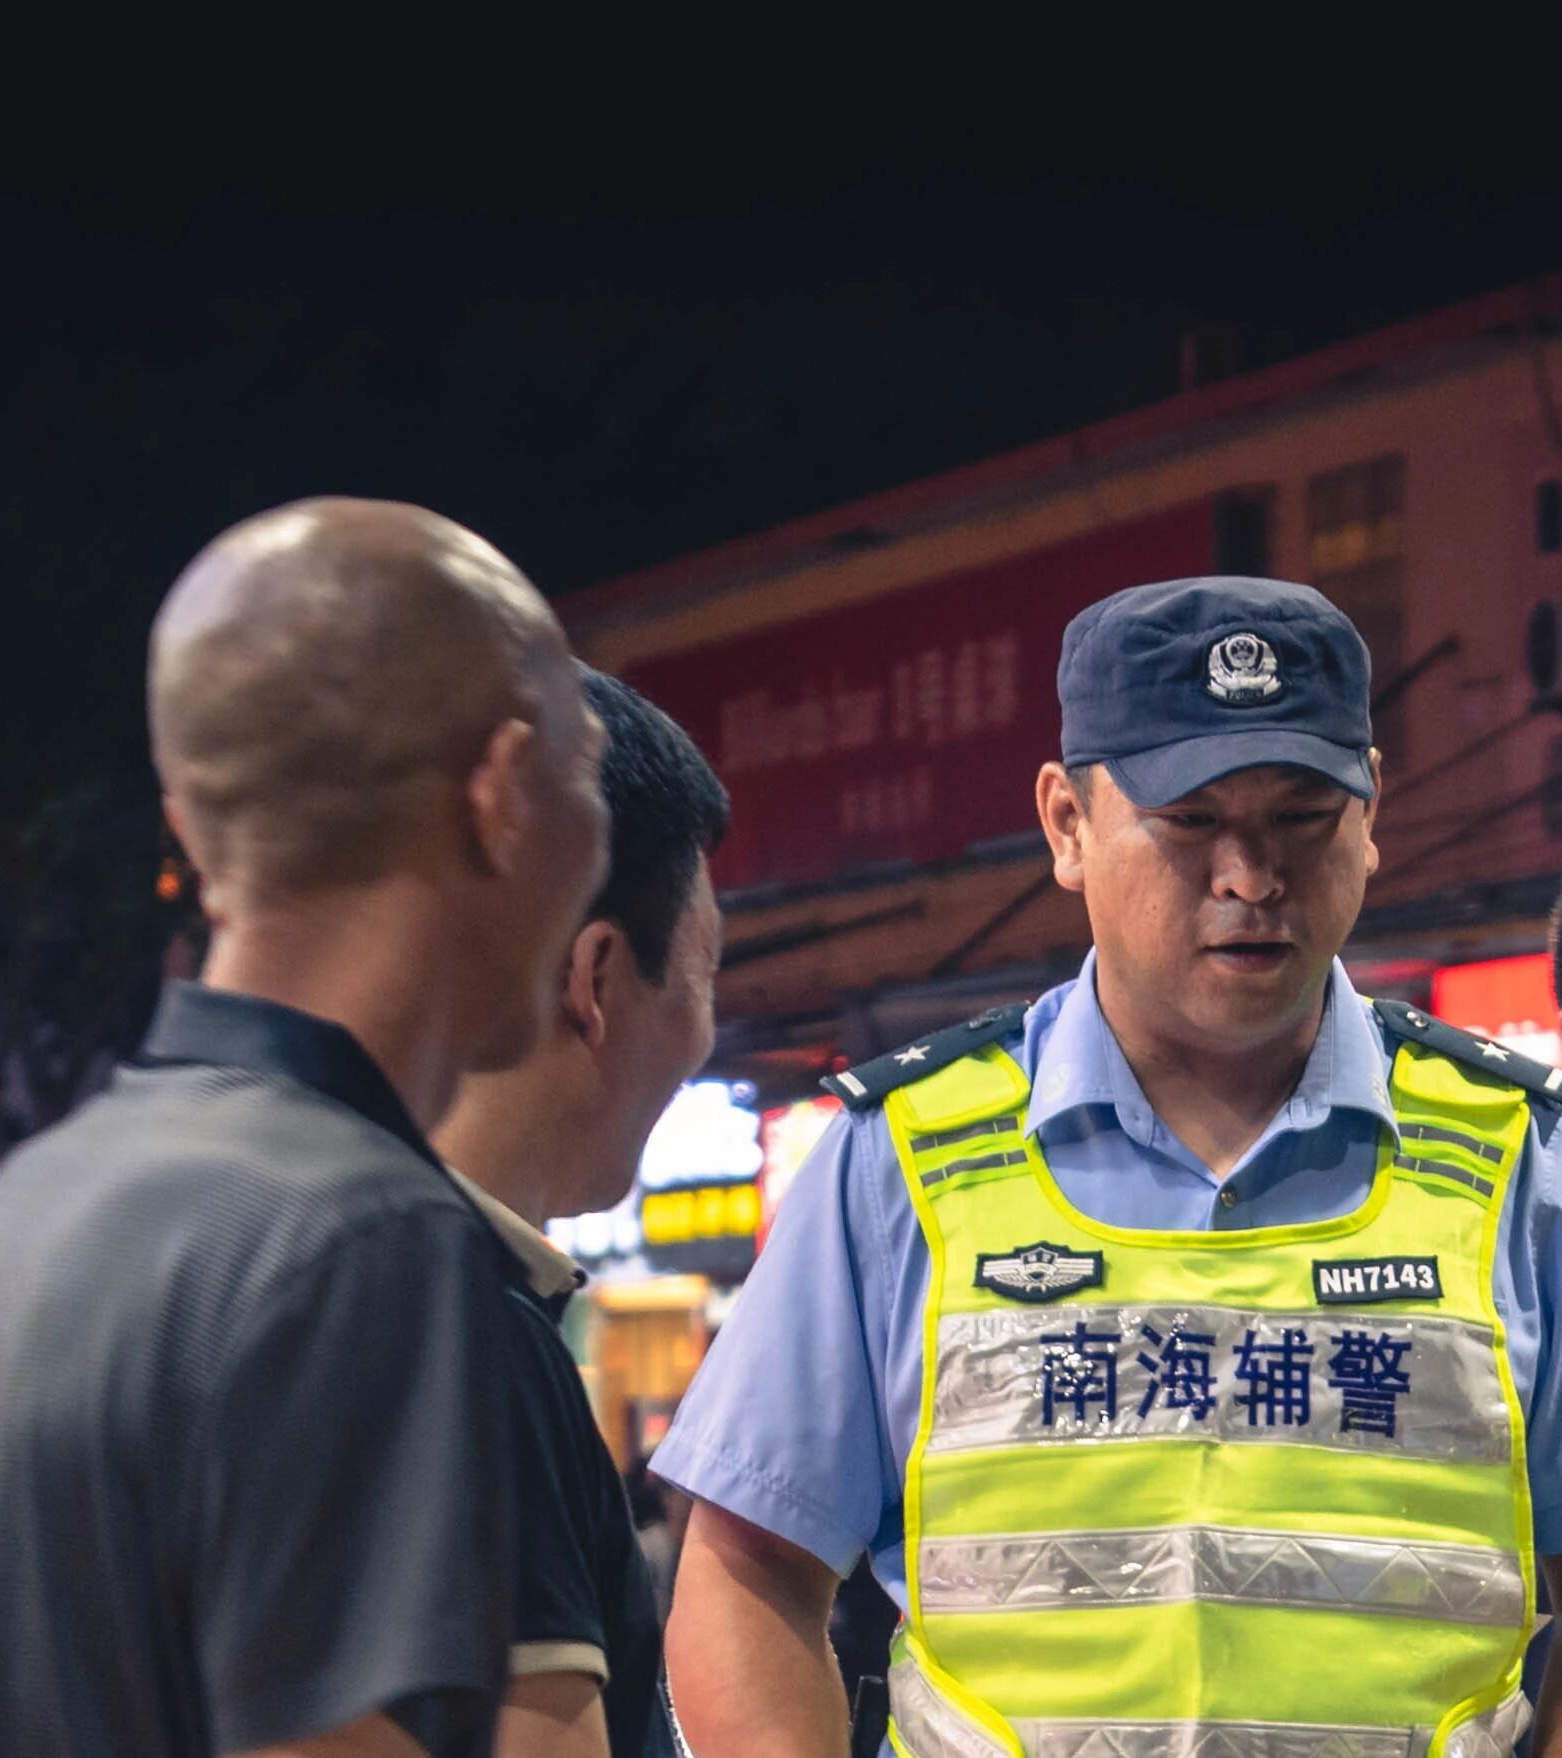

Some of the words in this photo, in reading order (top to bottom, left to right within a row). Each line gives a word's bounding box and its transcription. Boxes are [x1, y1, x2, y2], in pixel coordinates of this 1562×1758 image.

[1320, 1264, 1436, 1293] NH7143
[1039, 1323, 1412, 1438] 南海辅警
